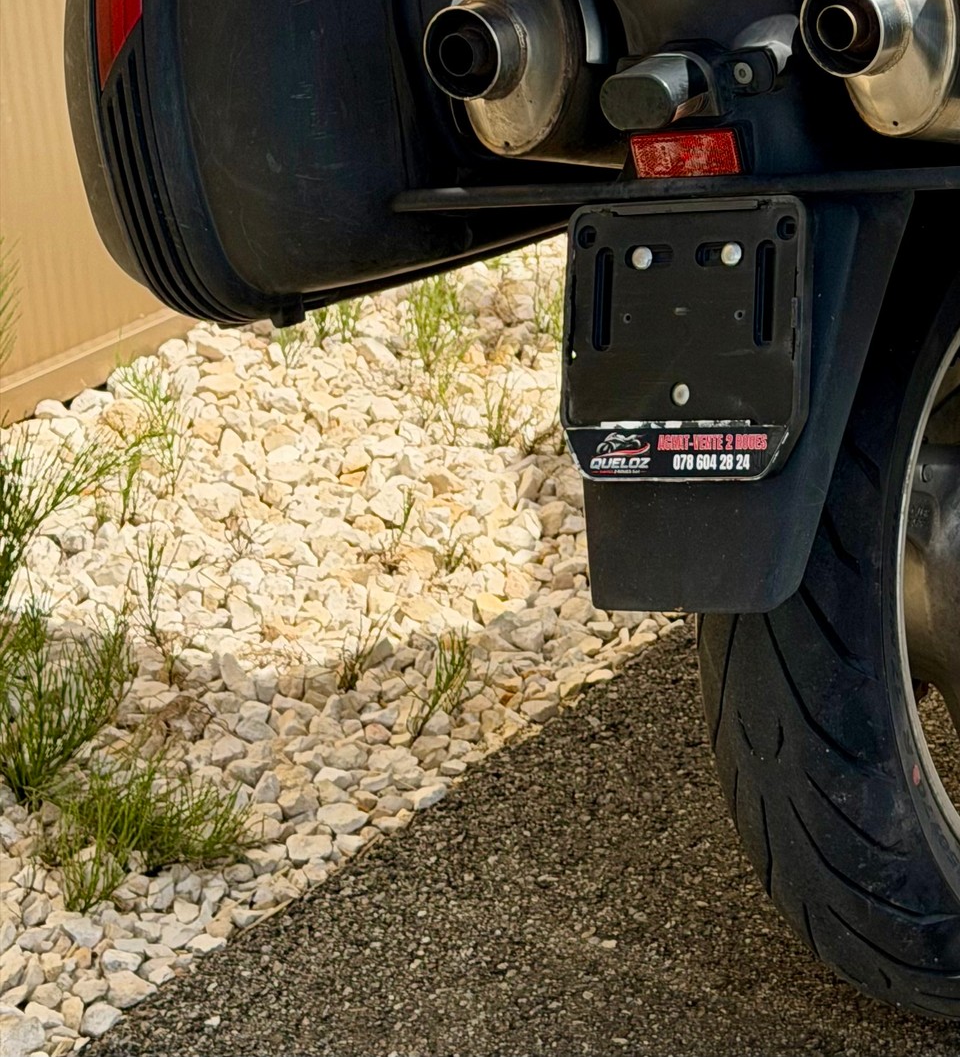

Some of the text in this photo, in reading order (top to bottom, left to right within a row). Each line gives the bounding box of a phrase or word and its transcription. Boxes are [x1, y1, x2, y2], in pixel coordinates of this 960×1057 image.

[725, 434, 734, 450] 2
[590, 457, 651, 470] QUELOZ
[672, 454, 751, 471] 078 604 28 24
